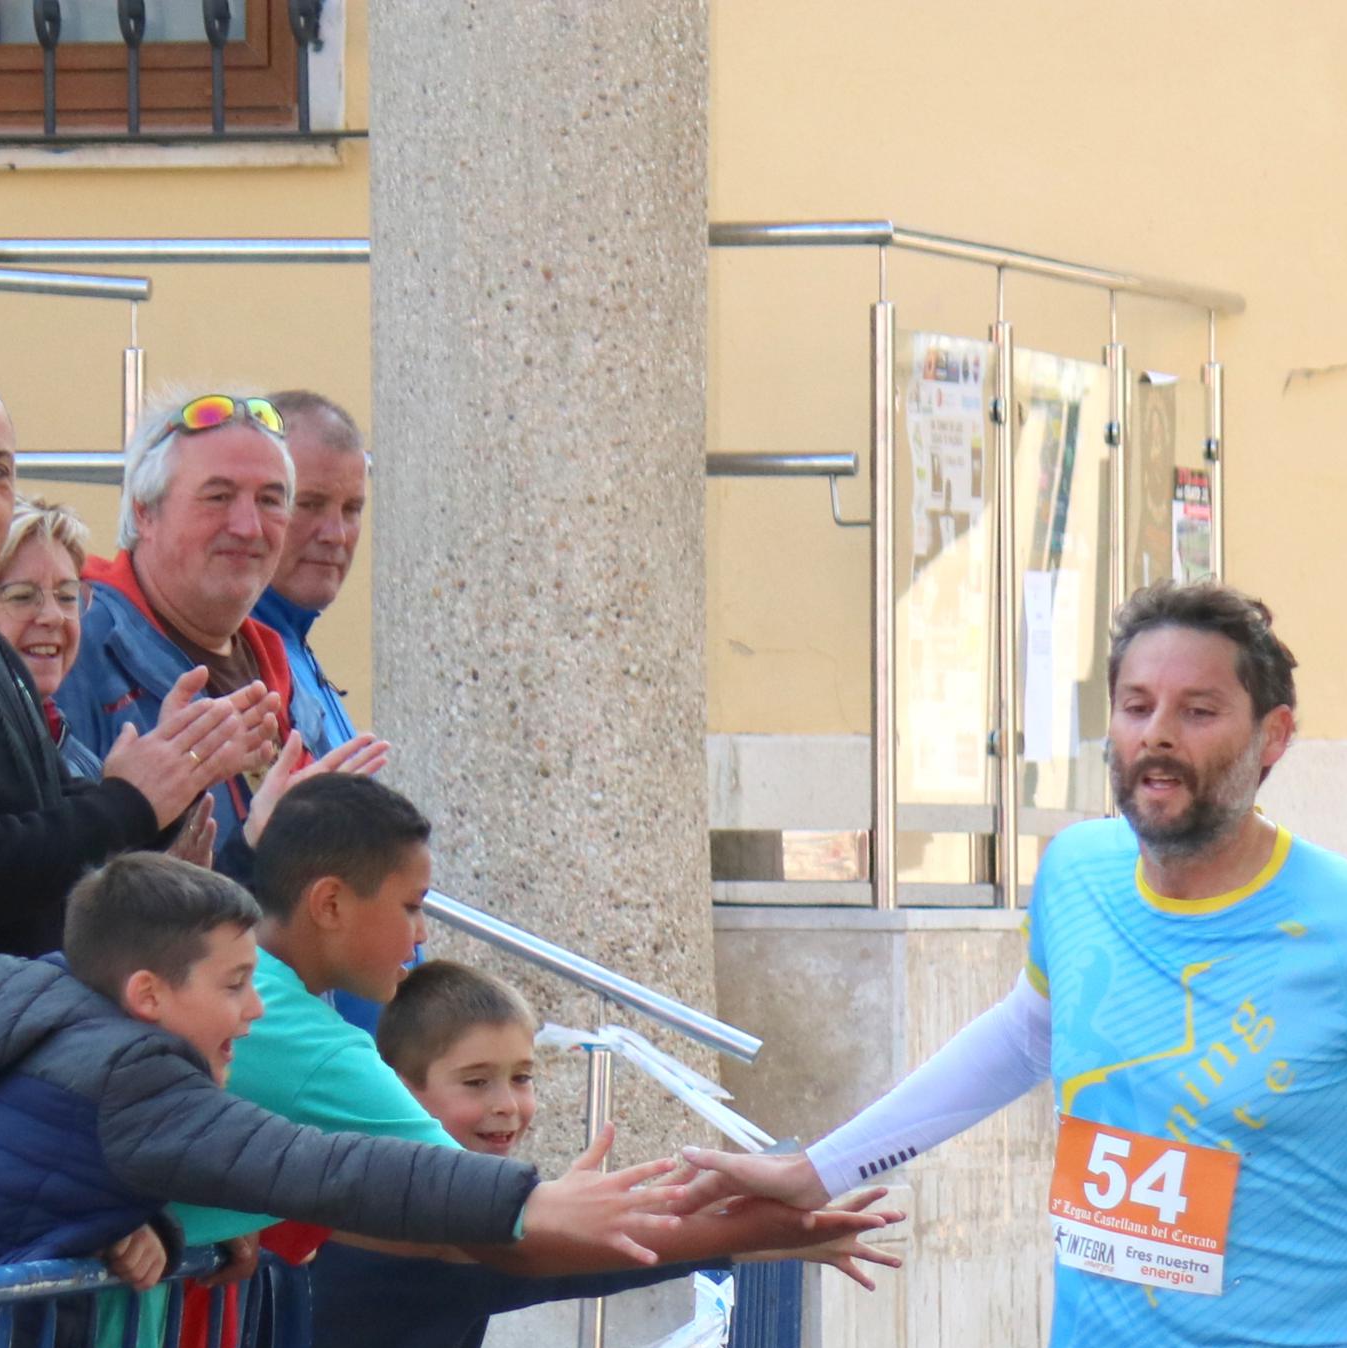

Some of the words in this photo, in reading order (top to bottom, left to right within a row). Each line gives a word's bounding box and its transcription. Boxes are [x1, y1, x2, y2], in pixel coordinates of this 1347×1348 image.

[1083, 1132, 1188, 1225] 54
[1063, 1199, 1092, 1221] Legua
[1093, 1211, 1148, 1236] Castellana
[1151, 1225, 1168, 1239] del
[1171, 1229, 1218, 1249] Cerrato
[1066, 1233, 1115, 1265] INTEGRA
[1125, 1246, 1153, 1263] Eres
[1156, 1253, 1210, 1274] nuestra
[1140, 1264, 1195, 1285] energía
